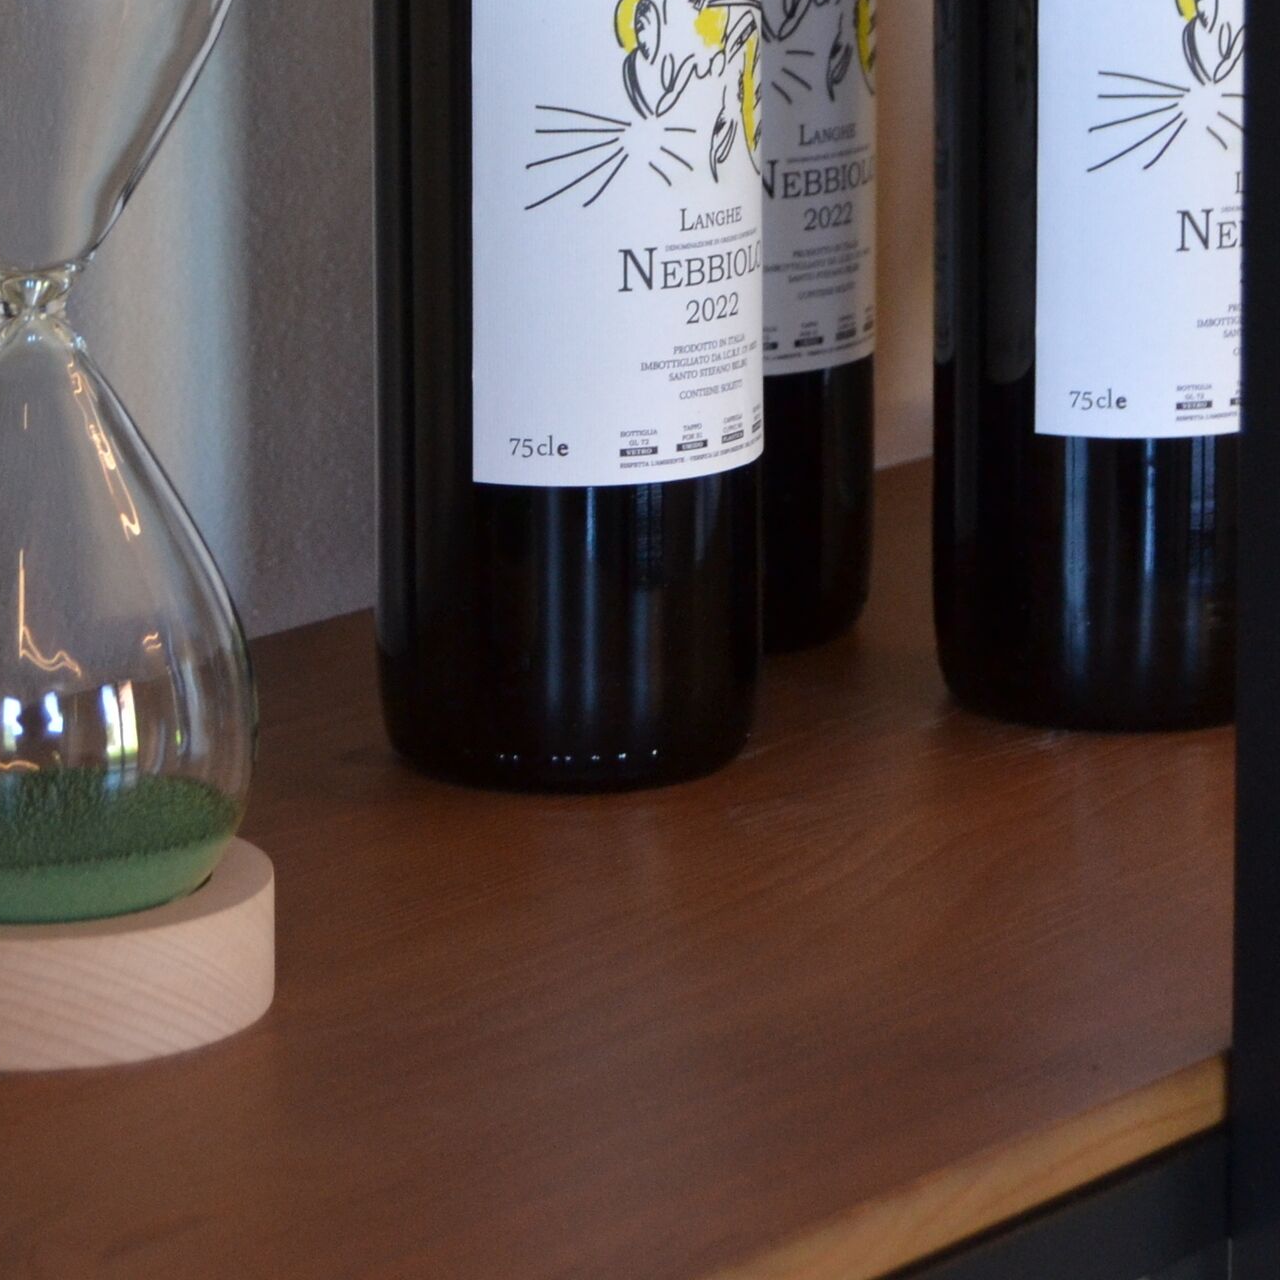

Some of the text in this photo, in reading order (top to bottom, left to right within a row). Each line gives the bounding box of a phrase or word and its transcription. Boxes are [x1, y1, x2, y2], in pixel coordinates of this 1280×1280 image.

[680, 206, 742, 231] LANGHE
[804, 201, 853, 231] 2022
[686, 292, 739, 325] 2022
[673, 340, 718, 356] PRODOTTO
[640, 354, 710, 371] IMBOTTIGLIATO
[668, 369, 698, 382] SANTO
